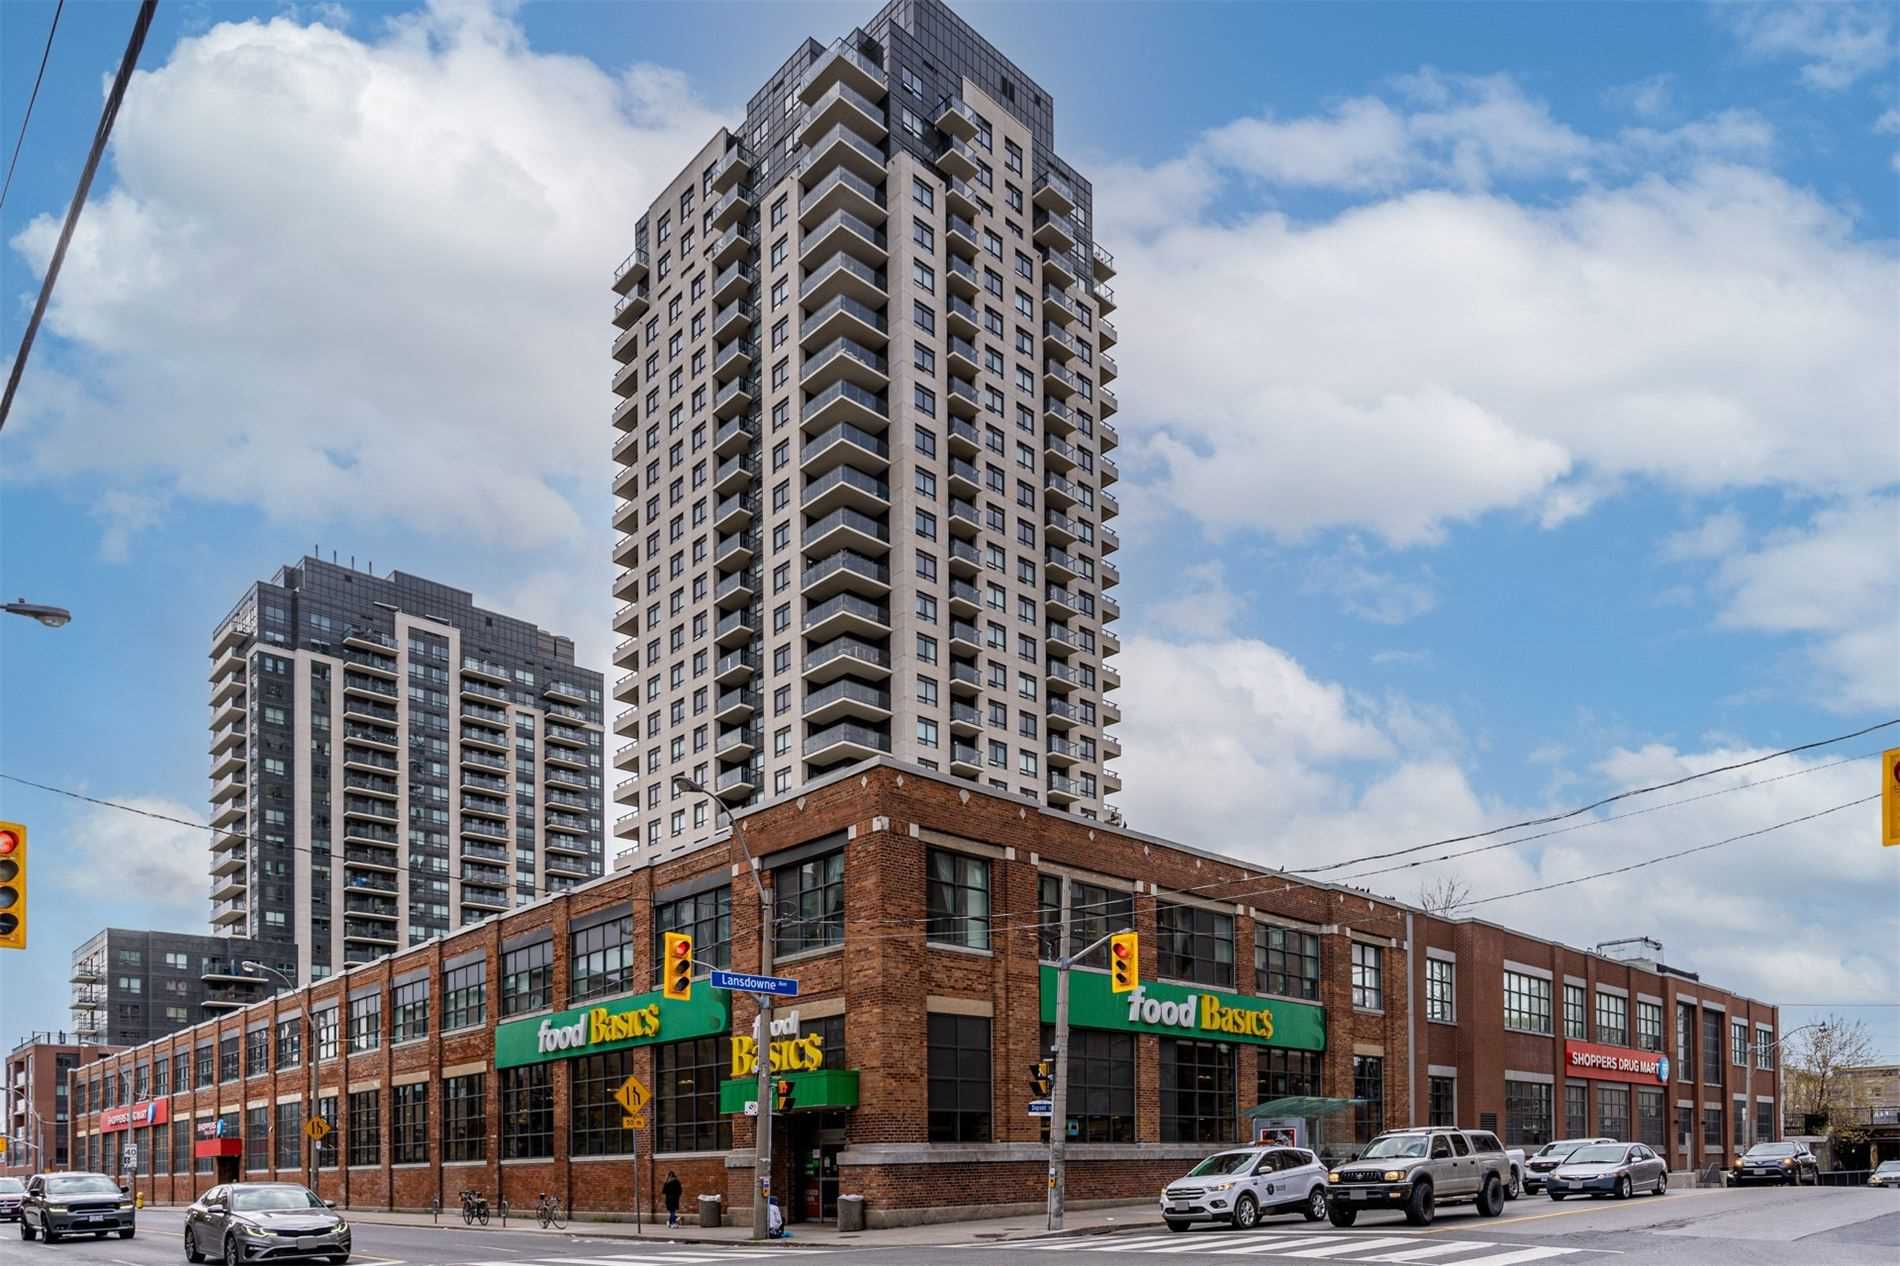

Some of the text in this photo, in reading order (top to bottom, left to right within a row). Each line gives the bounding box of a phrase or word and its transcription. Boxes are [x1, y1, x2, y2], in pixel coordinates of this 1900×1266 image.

[722, 975, 776, 990] Lansdowne
[1128, 986, 1197, 1028] food
[538, 1013, 588, 1052] food
[752, 1010, 799, 1040] fod
[1572, 1052, 1617, 1070] SHOPPERS
[1619, 1059, 1639, 1072] DRUG
[1640, 1060, 1659, 1074] MART
